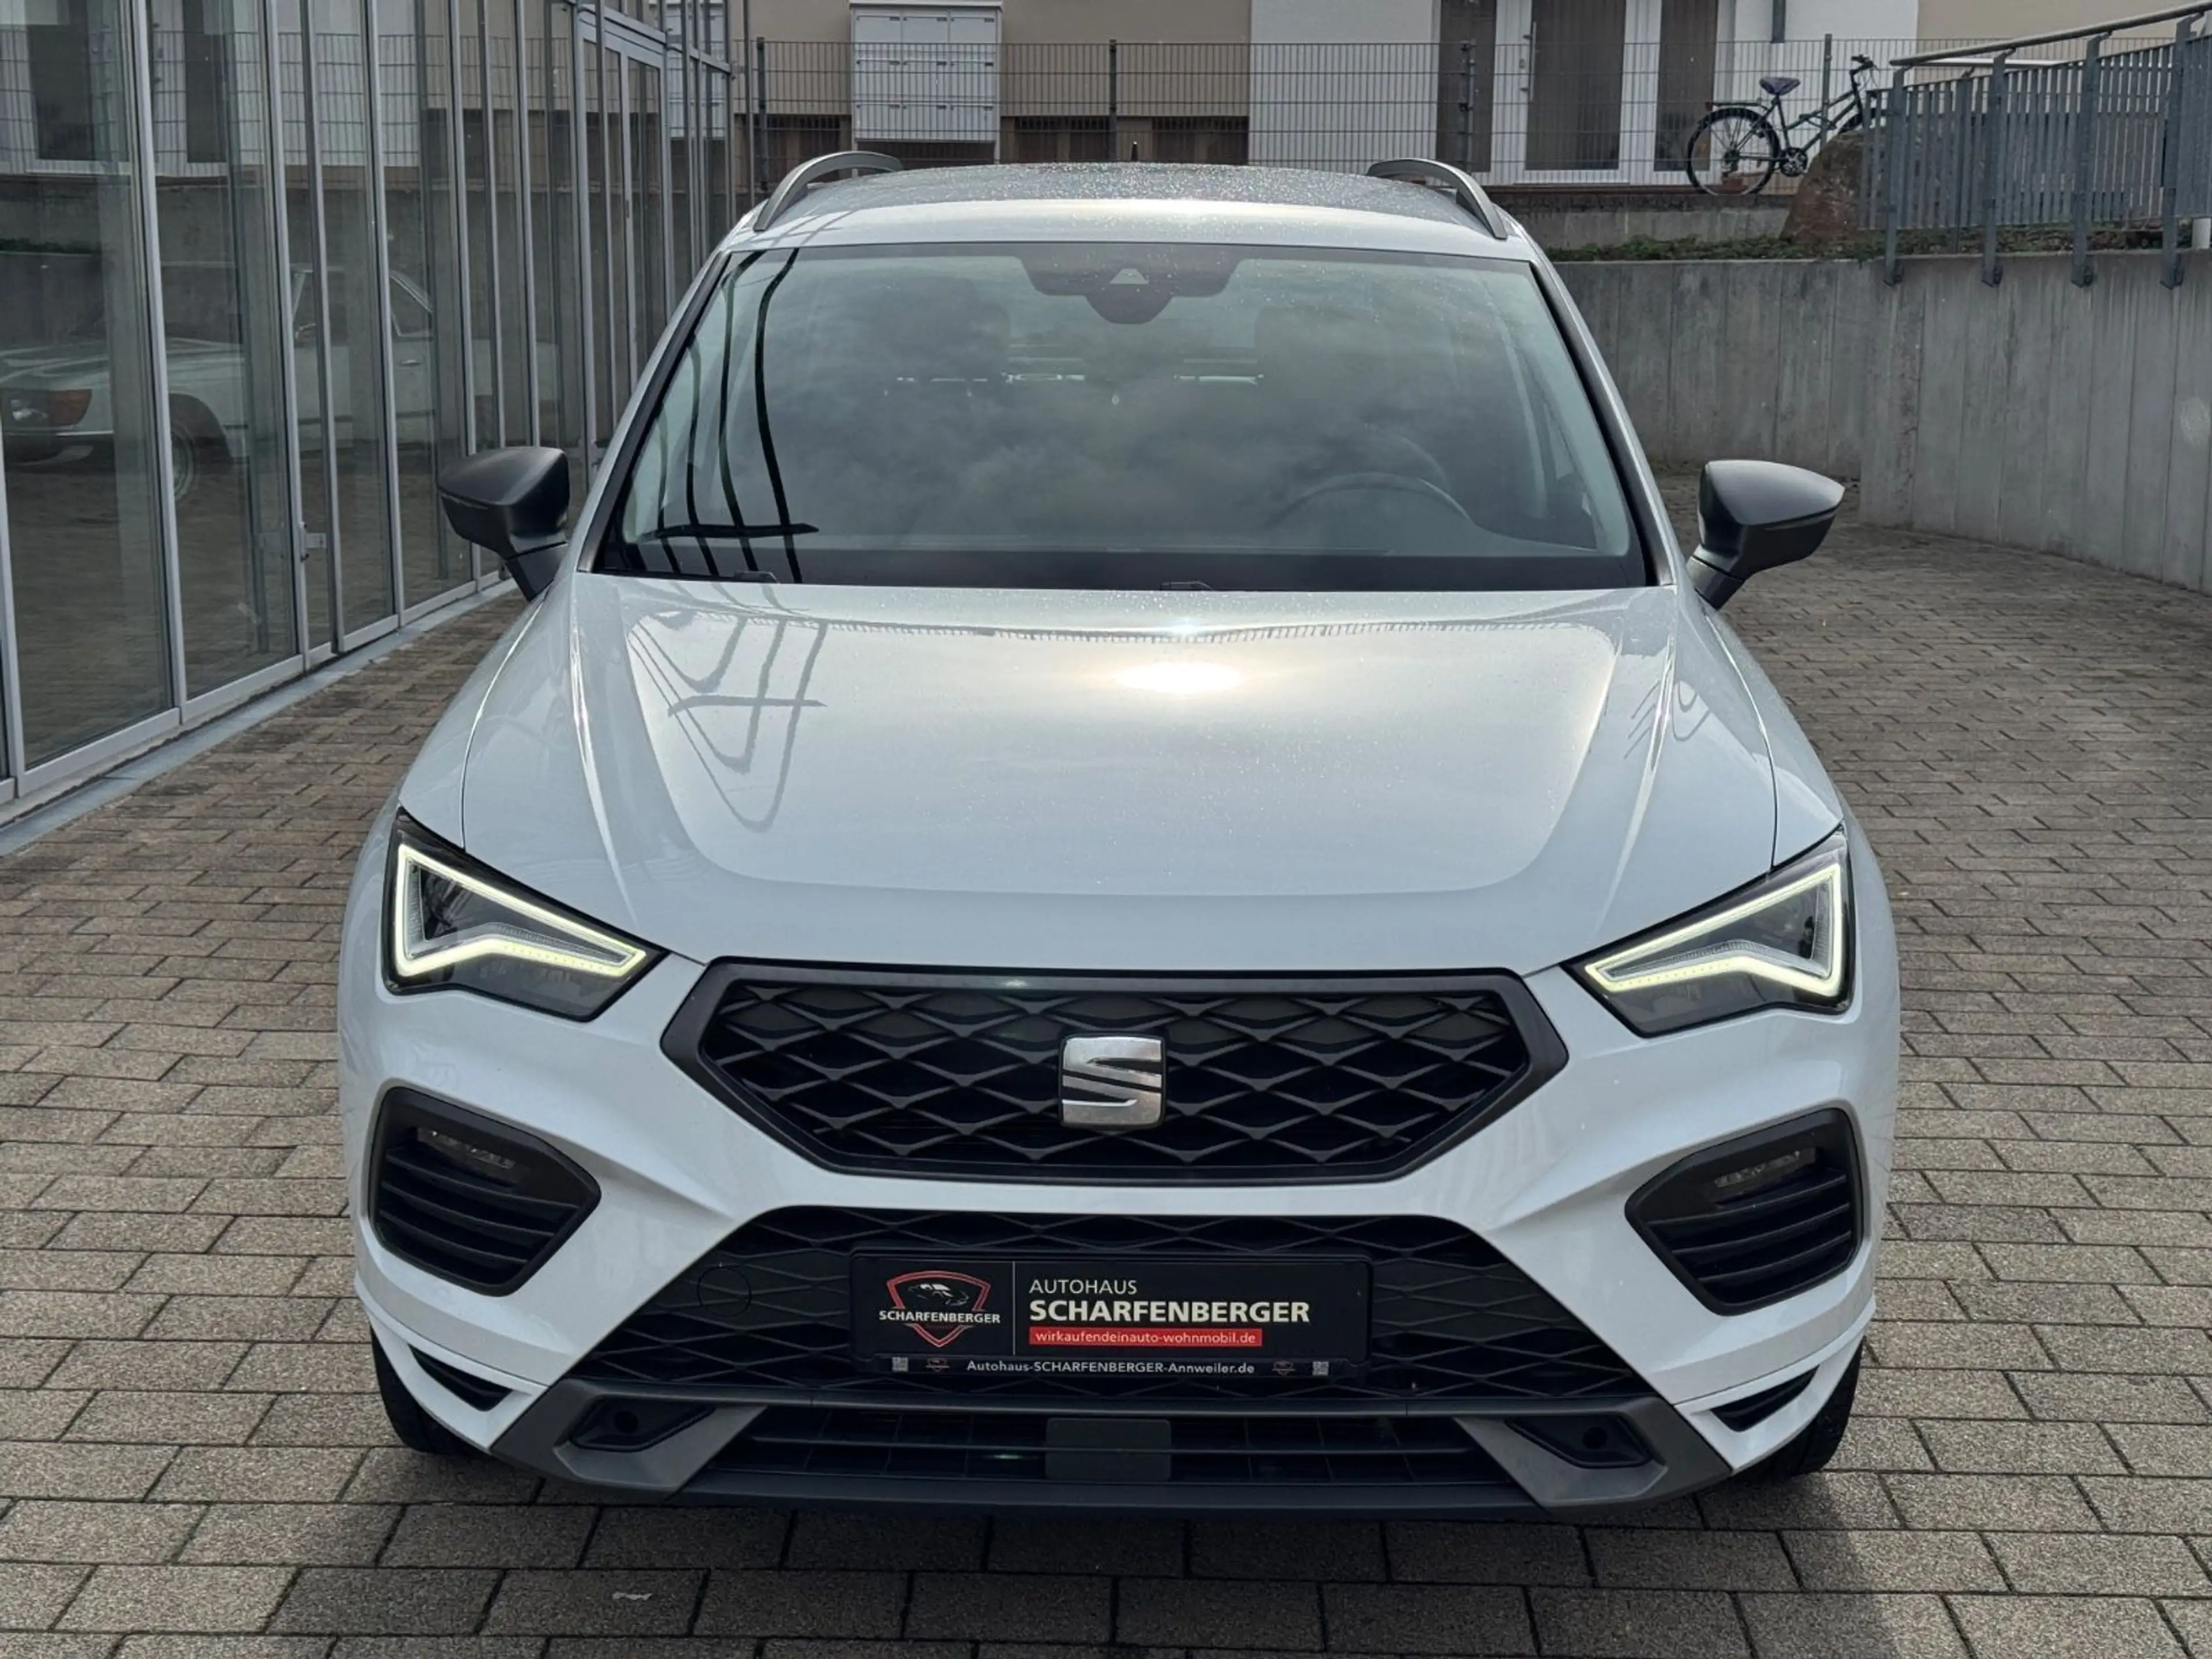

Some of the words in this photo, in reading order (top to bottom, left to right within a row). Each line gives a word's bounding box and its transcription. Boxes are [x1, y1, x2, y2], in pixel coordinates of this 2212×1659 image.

[1029, 1279, 1138, 1295] AUTOHAUS
[878, 1310, 1001, 1324] SCHARFENBERGER
[1029, 1300, 1310, 1323] SCHARFENBERGER
[1035, 1331, 1256, 1344] wirkaufendeinauto-wohnmobil.de
[967, 1359, 1255, 1374] Autohaus-SCHARFENBERGER-Annweiler.de
